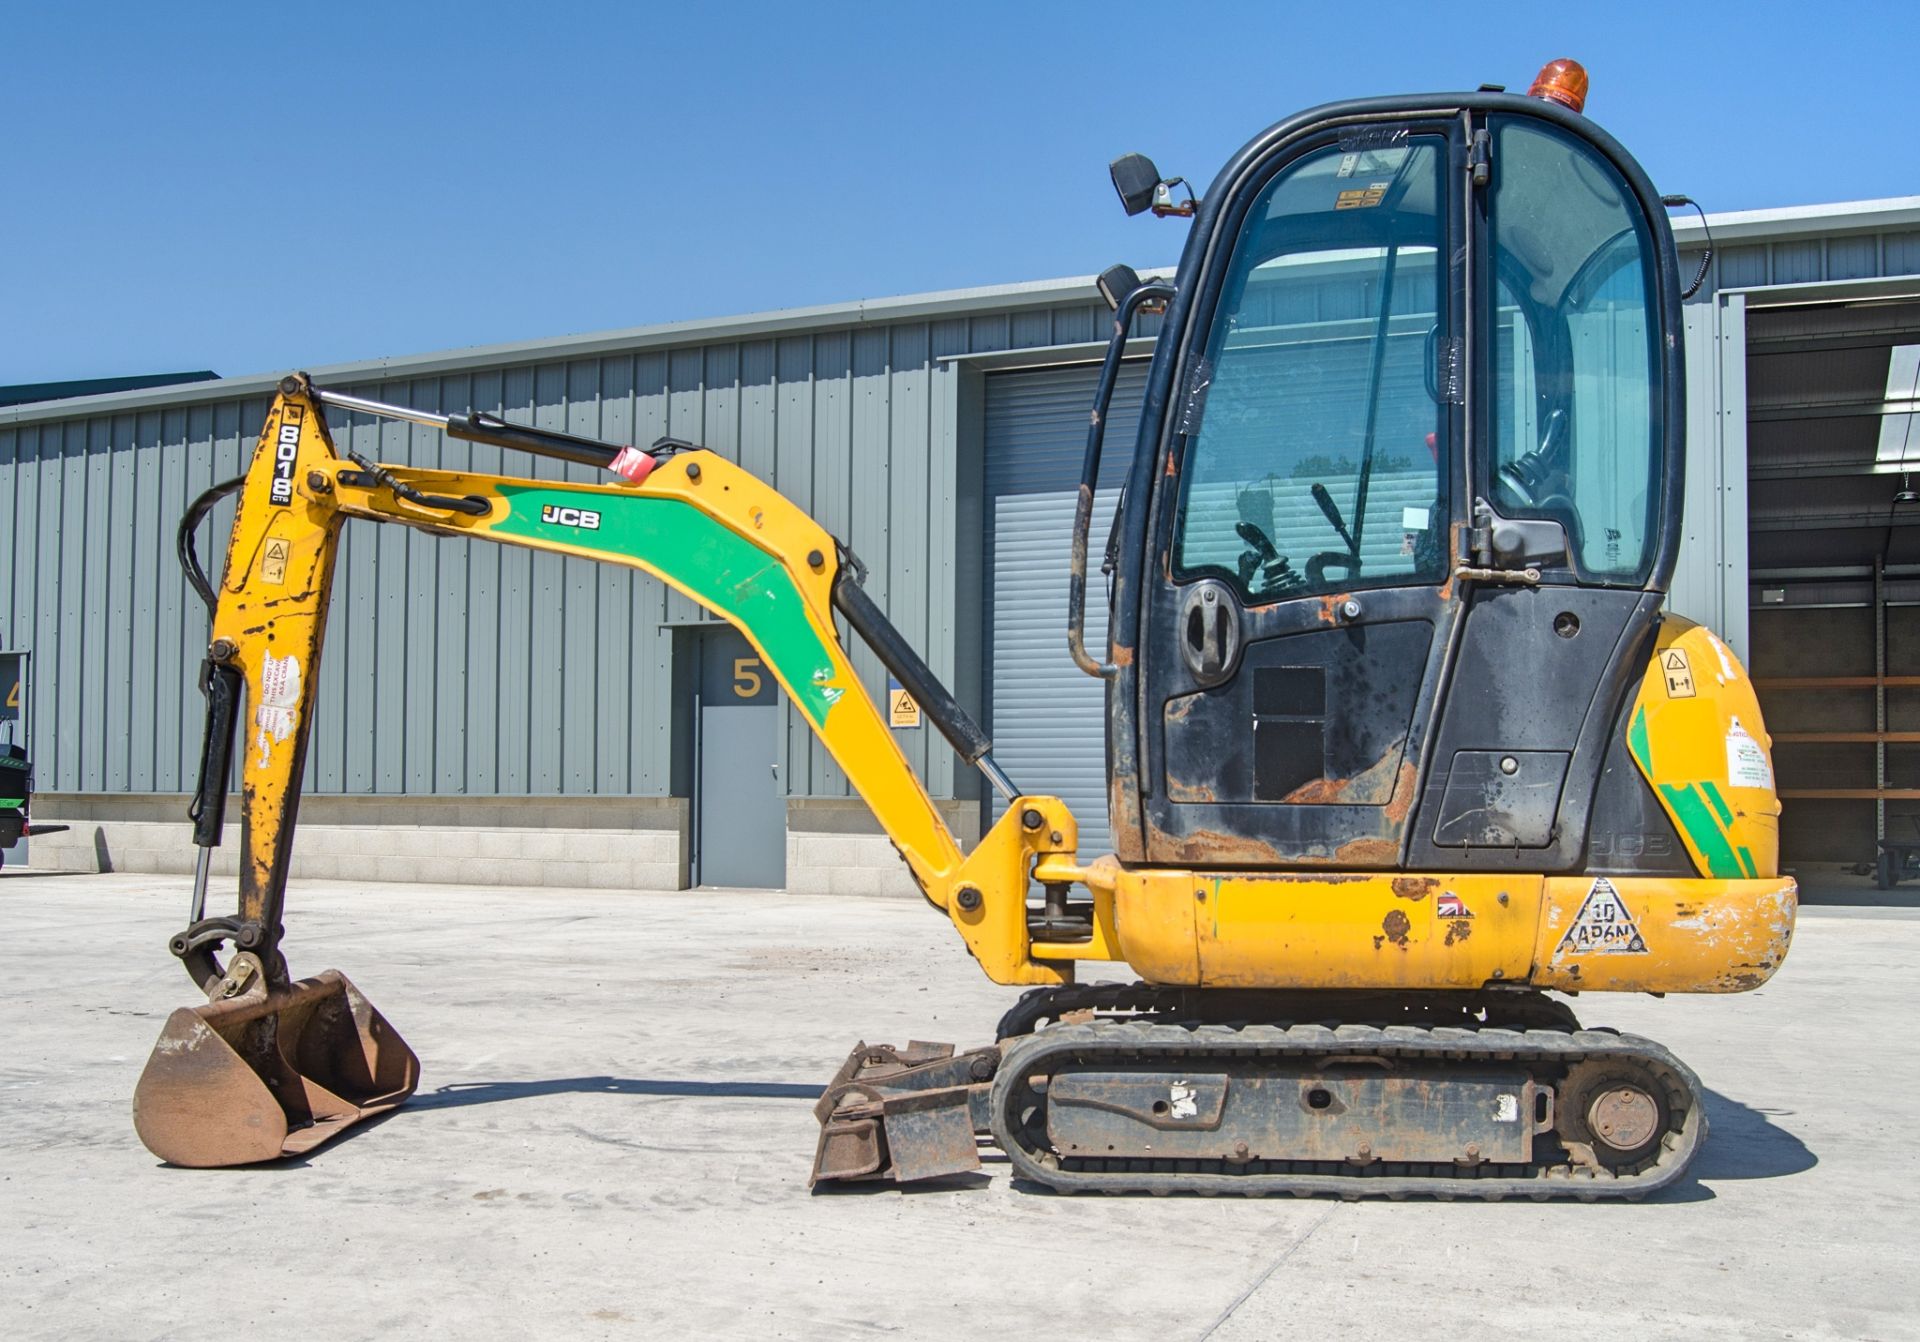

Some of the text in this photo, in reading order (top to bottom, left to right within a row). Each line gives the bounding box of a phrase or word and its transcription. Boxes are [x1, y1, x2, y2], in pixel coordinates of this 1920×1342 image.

[272, 425, 300, 496] 8018
[542, 506, 600, 529] JCB
[734, 658, 761, 697] 5
